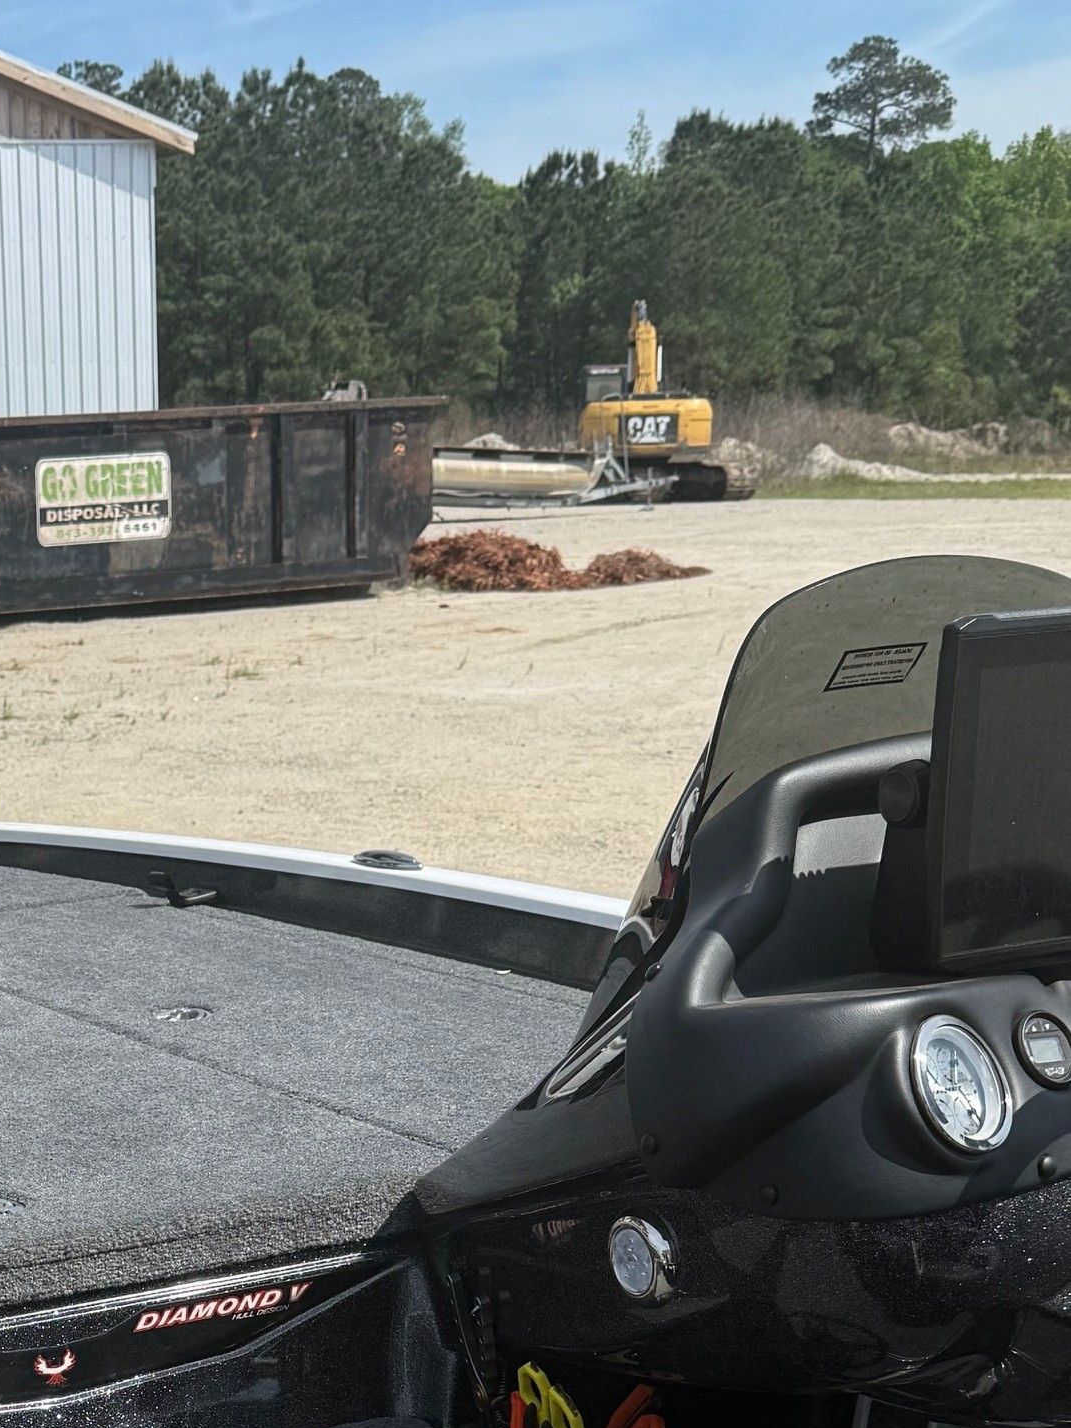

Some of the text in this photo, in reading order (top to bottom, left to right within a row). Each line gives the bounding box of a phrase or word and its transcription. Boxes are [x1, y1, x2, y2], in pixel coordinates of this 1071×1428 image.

[627, 415, 672, 443] CAT
[42, 461, 162, 501] GO GREEN
[133, 503, 160, 517] LLC
[133, 1281, 313, 1333] DIAMOND V
